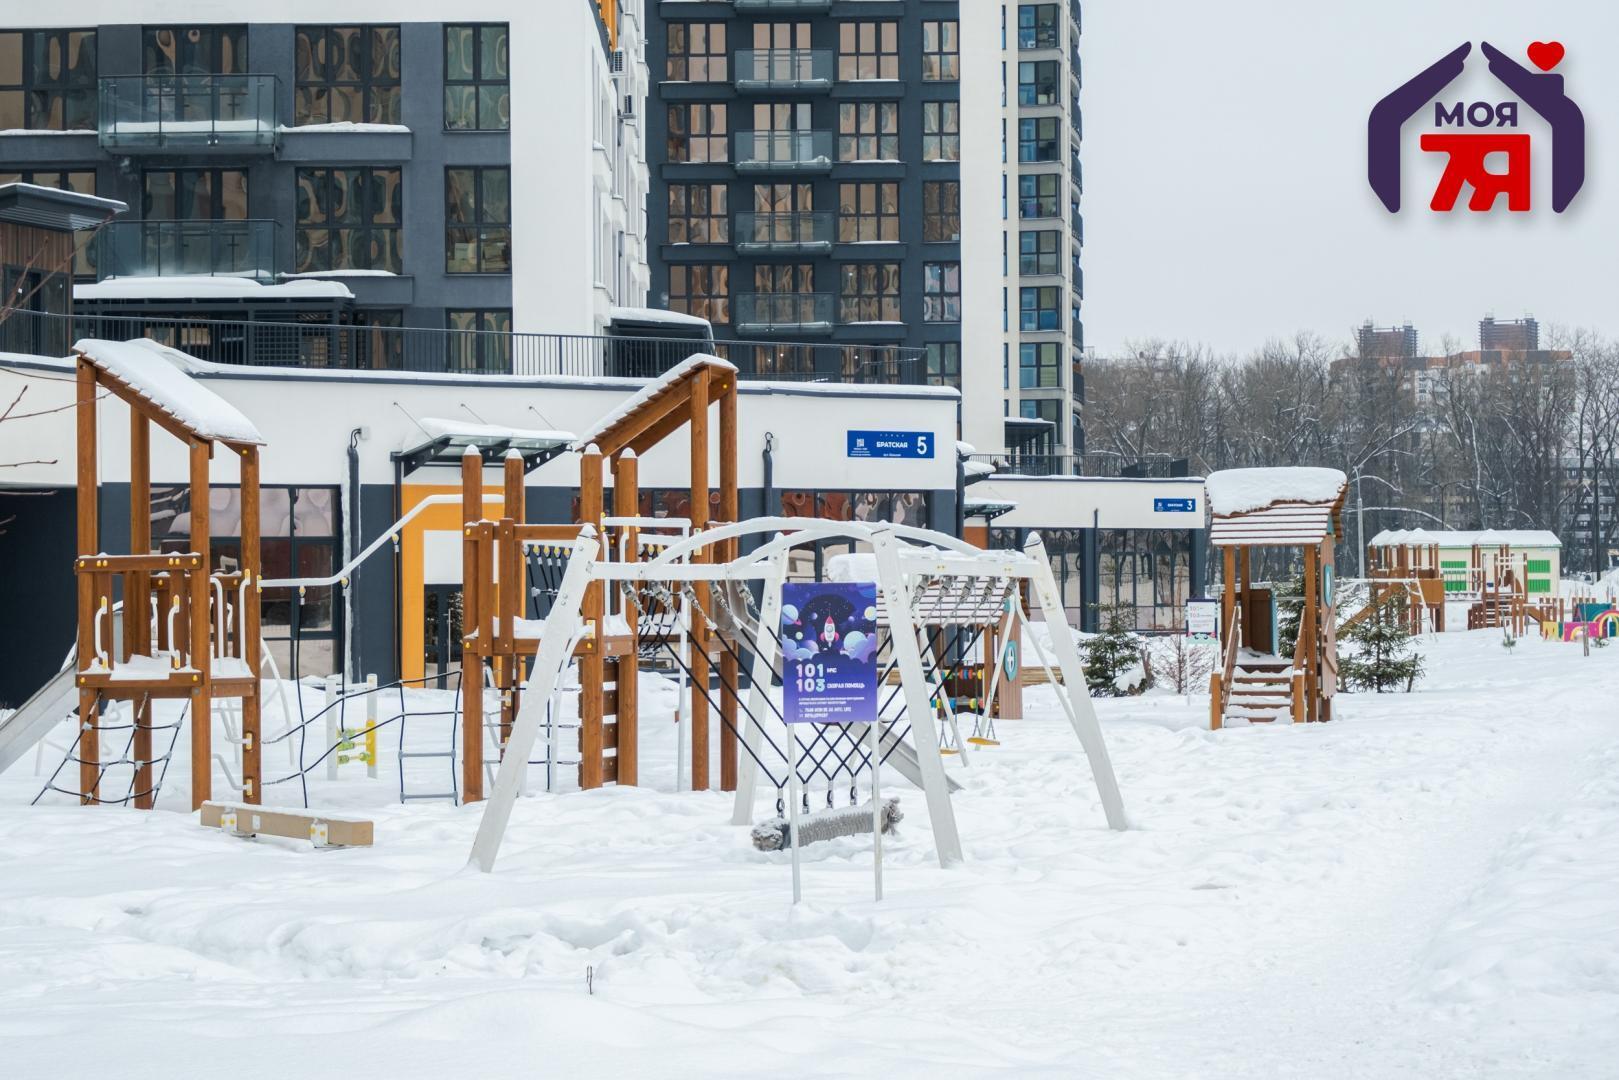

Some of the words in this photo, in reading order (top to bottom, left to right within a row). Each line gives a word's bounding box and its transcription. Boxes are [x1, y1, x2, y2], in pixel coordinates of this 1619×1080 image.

[916, 436, 928, 455] 5
[1186, 500, 1193, 511] 3
[796, 663, 824, 678] 101
[796, 678, 826, 692] 103
